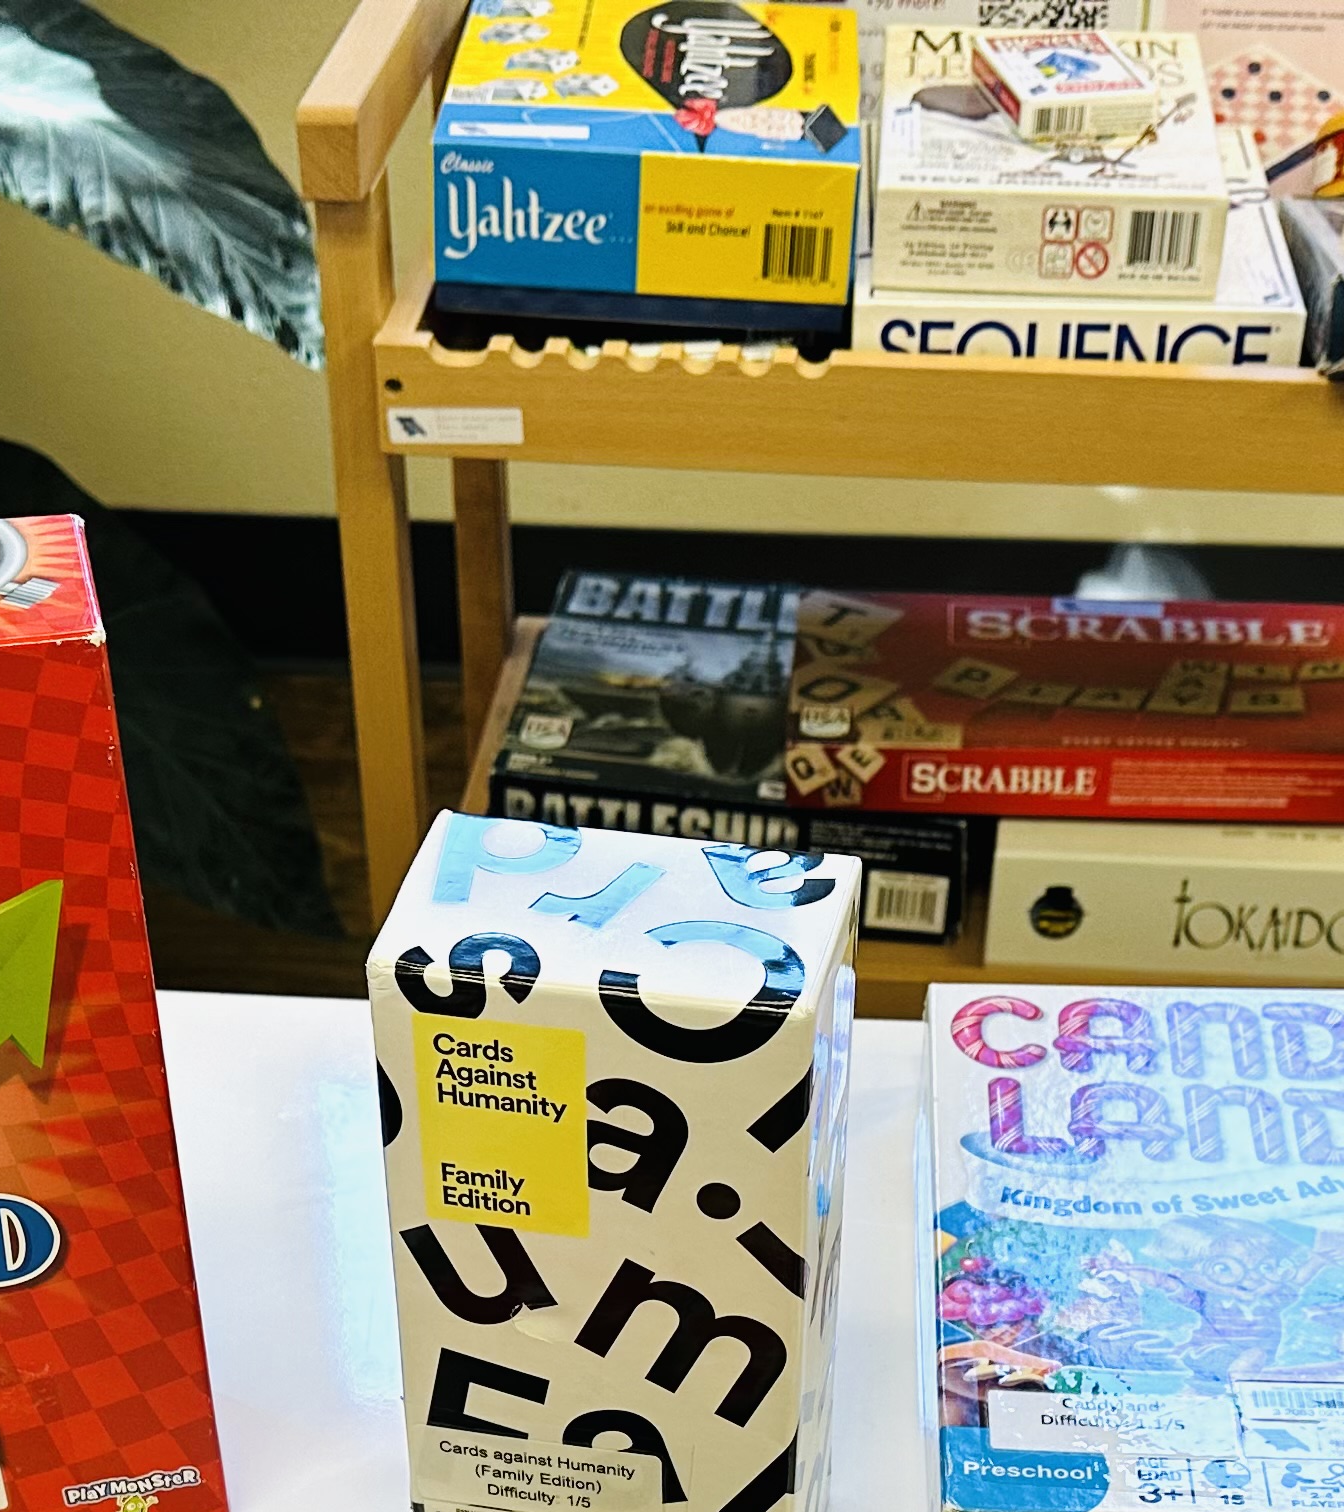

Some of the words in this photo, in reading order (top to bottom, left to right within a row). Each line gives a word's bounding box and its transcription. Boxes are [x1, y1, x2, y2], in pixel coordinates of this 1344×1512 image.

[440, 151, 495, 175] Classic
[443, 175, 608, 260] Yahtzee
[966, 610, 1336, 648] SCRABBLE
[911, 762, 1096, 796] SCRABBLE
[433, 1033, 514, 1064] Cards
[435, 1058, 538, 1092] Against
[437, 1083, 567, 1123] Humanity
[440, 1162, 525, 1197] Family
[442, 1186, 531, 1217] Edition
[1000, 1185, 1143, 1218] Kingdom
[1151, 1196, 1184, 1214] of
[1191, 1186, 1291, 1213] Sweet
[440, 1440, 488, 1459] Cards
[493, 1451, 552, 1468] against
[558, 1457, 635, 1481] Humanity
[963, 1460, 1093, 1482] Preschool
[475, 1464, 533, 1485] (Family
[540, 1473, 602, 1495] Edition)
[567, 1495, 591, 1509] 1/5
